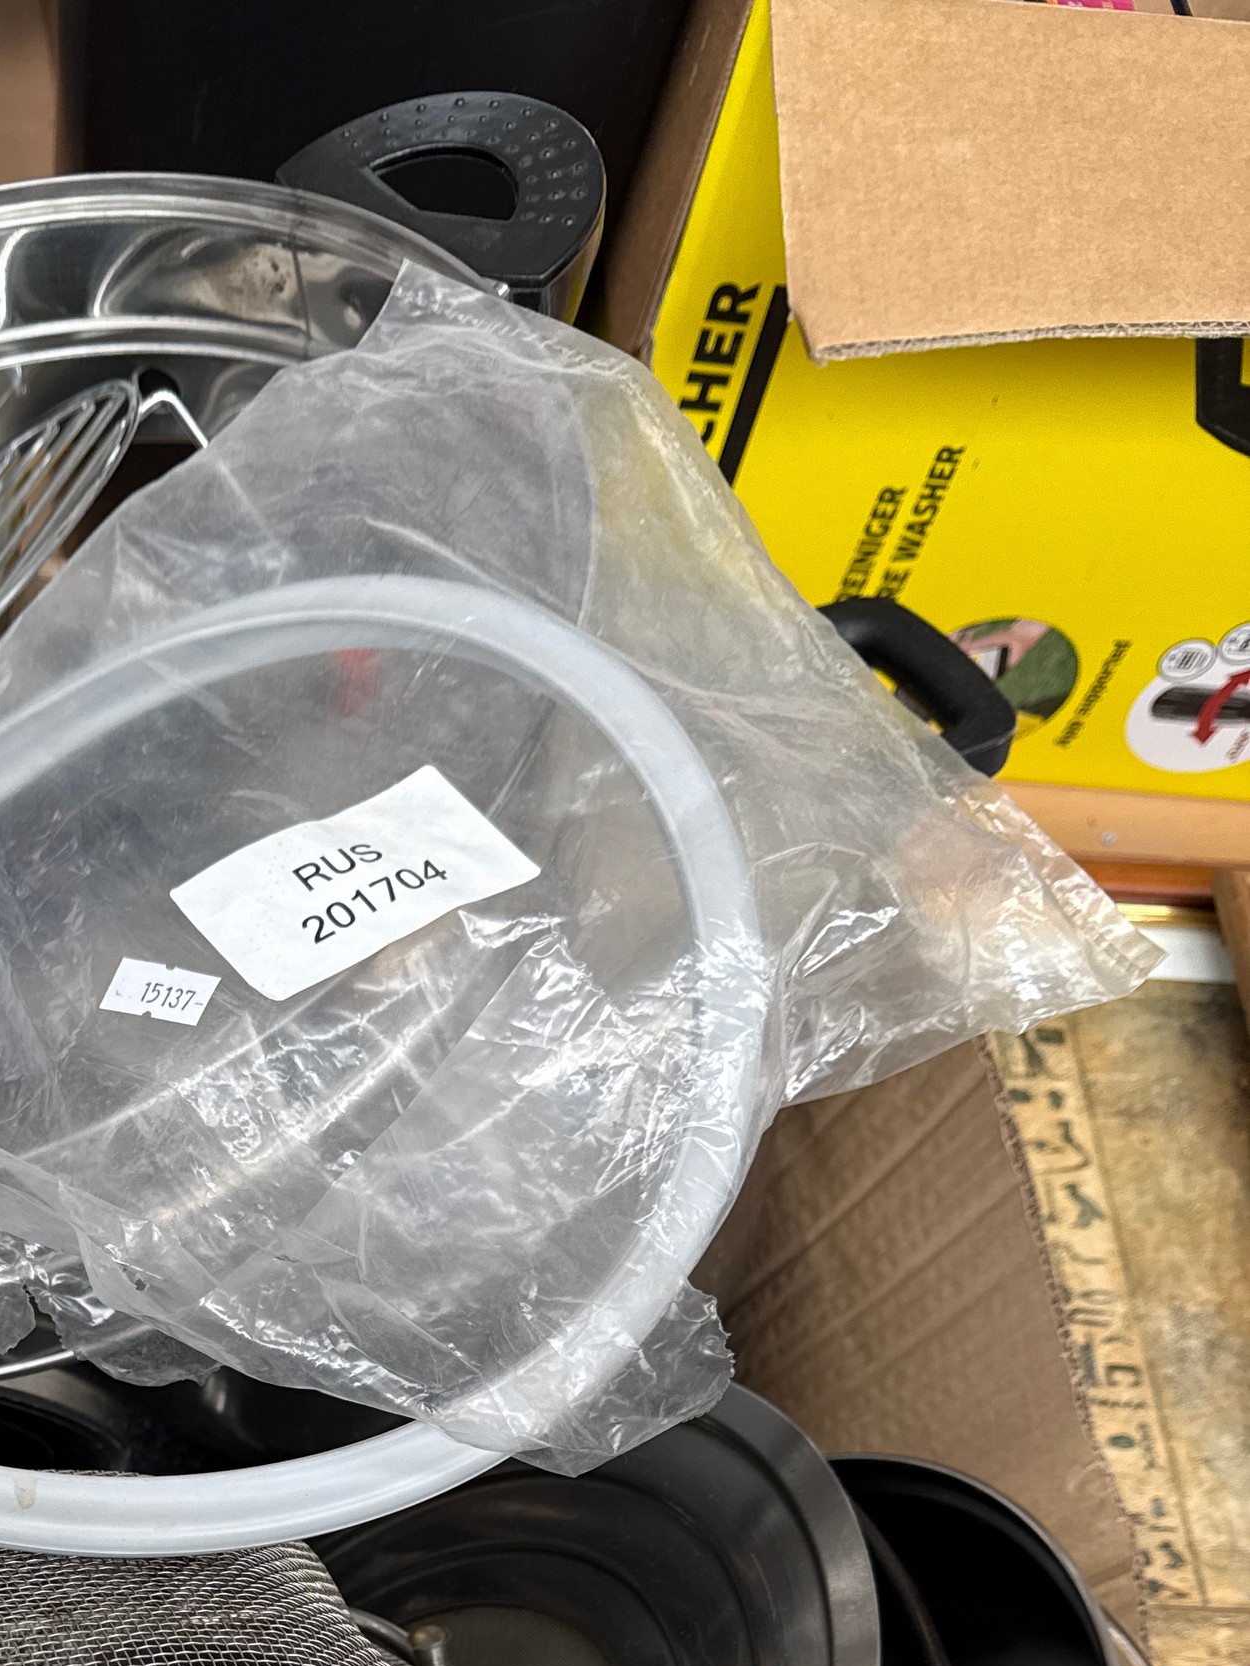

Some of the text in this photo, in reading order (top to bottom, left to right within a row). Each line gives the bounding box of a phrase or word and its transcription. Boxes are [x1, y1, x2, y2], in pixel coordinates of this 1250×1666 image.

[891, 446, 966, 562] WASHER
[291, 844, 383, 892] RUS
[301, 859, 448, 944] 201704
[140, 981, 197, 1011] 15137
